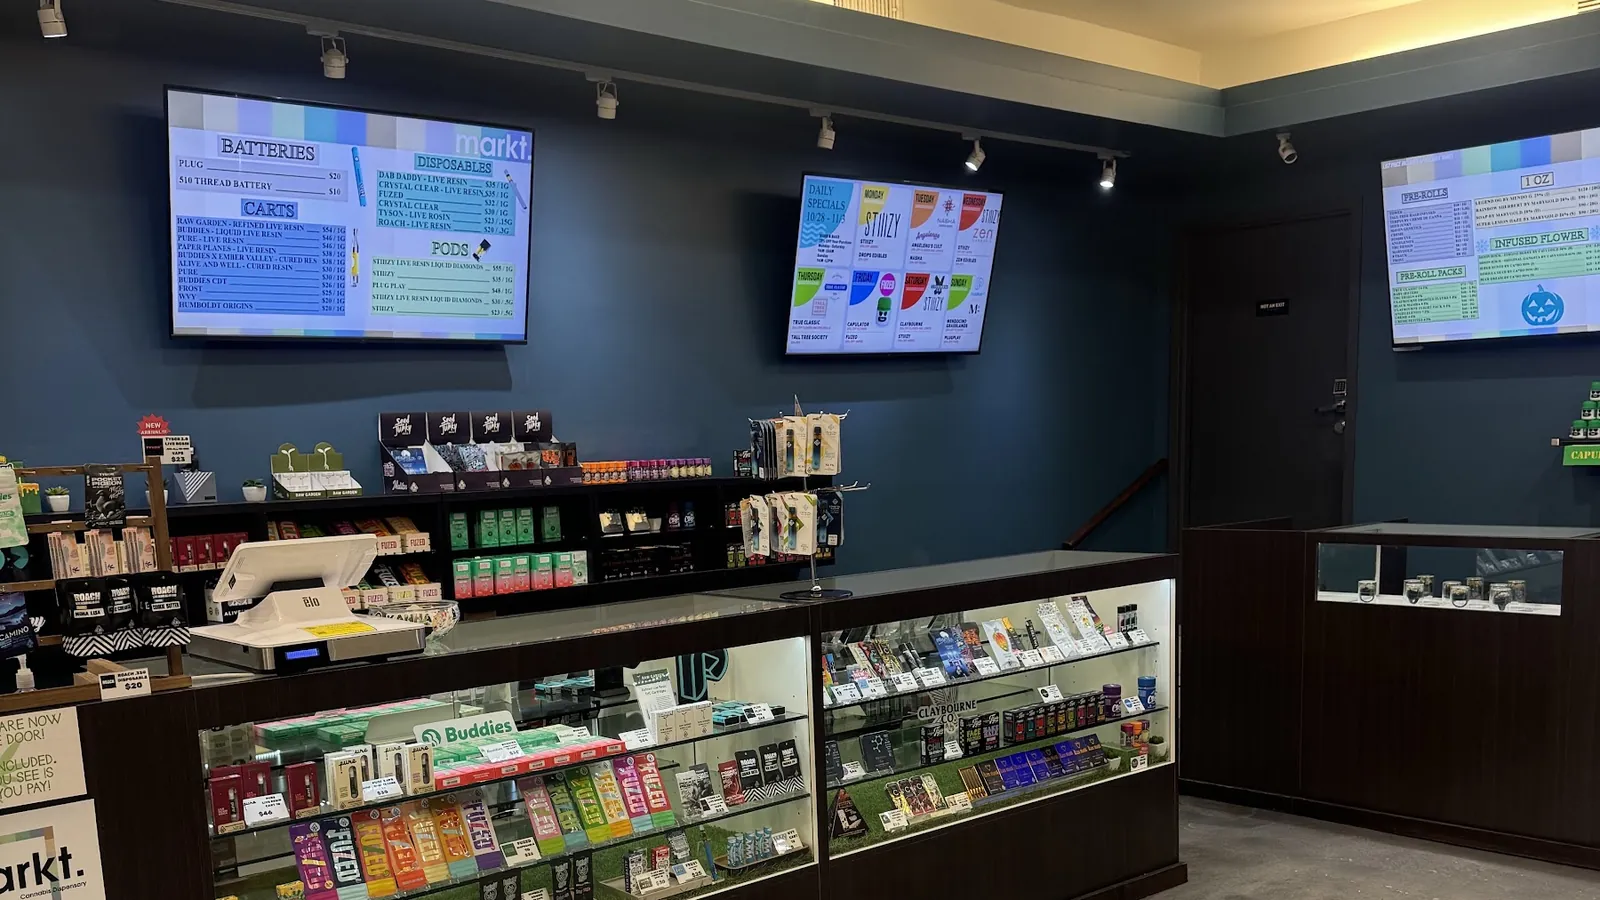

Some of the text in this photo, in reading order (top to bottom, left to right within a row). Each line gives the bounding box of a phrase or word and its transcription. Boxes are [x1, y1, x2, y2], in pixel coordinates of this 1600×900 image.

[221, 138, 315, 161] BATTERIES
[456, 133, 531, 160] markt.
[179, 160, 203, 168] PLUG
[418, 156, 491, 173] DISPOSABLES
[194, 177, 231, 187] THREAD
[233, 180, 272, 190] BATTERY
[379, 171, 468, 185] DAB DADDY LIVE RESIN
[1526, 175, 1549, 186] 1 OZ
[379, 181, 412, 190] CRYSTAL
[415, 184, 439, 192] CLEAR
[809, 184, 834, 196] DAILY
[864, 189, 884, 199] MONDAY
[915, 193, 934, 203] TUESDAY
[1403, 189, 1447, 202] PRE-ROLLS
[244, 202, 294, 217] CARTS
[379, 200, 412, 208] CRYSTAL
[808, 199, 846, 210] SPECIALS
[410, 211, 428, 219] LIVE
[807, 212, 825, 222] 10/28
[284, 223, 304, 231] RESIN
[379, 219, 406, 227] ROACH
[864, 212, 901, 238] STIIIZY
[973, 227, 993, 239] zen
[1495, 231, 1585, 248] INFUSED FLOWER
[432, 241, 468, 256] PODS
[246, 254, 273, 262] VALLEY
[798, 272, 823, 281] THURSDAY
[856, 273, 873, 282] FRIDAY
[905, 275, 927, 285] SATURDAY
[1400, 268, 1462, 280] PRE-ROLL PACKS
[950, 278, 967, 287] SUNDAY
[381, 541, 397, 550] FUZED
[151, 585, 177, 595] ROACH
[423, 589, 437, 597] FUZED
[74, 592, 100, 601] ROACH
[368, 595, 383, 603] FUZED
[0, 625, 29, 641] CAMINO
[125, 681, 142, 691] $20
[919, 700, 976, 718] CLAYBOURNE
[0, 713, 61, 731] ARE NOW
[941, 714, 954, 723] CO.
[7, 729, 44, 745] DOOR!
[445, 720, 512, 742] Buddies
[17, 769, 39, 782] SEE
[44, 767, 53, 778] IS
[27, 780, 51, 794] PAY!
[621, 768, 648, 814] FUZED
[638, 762, 668, 808] FUZED
[326, 829, 362, 883] FUZED
[20, 887, 51, 899] Cannabis
